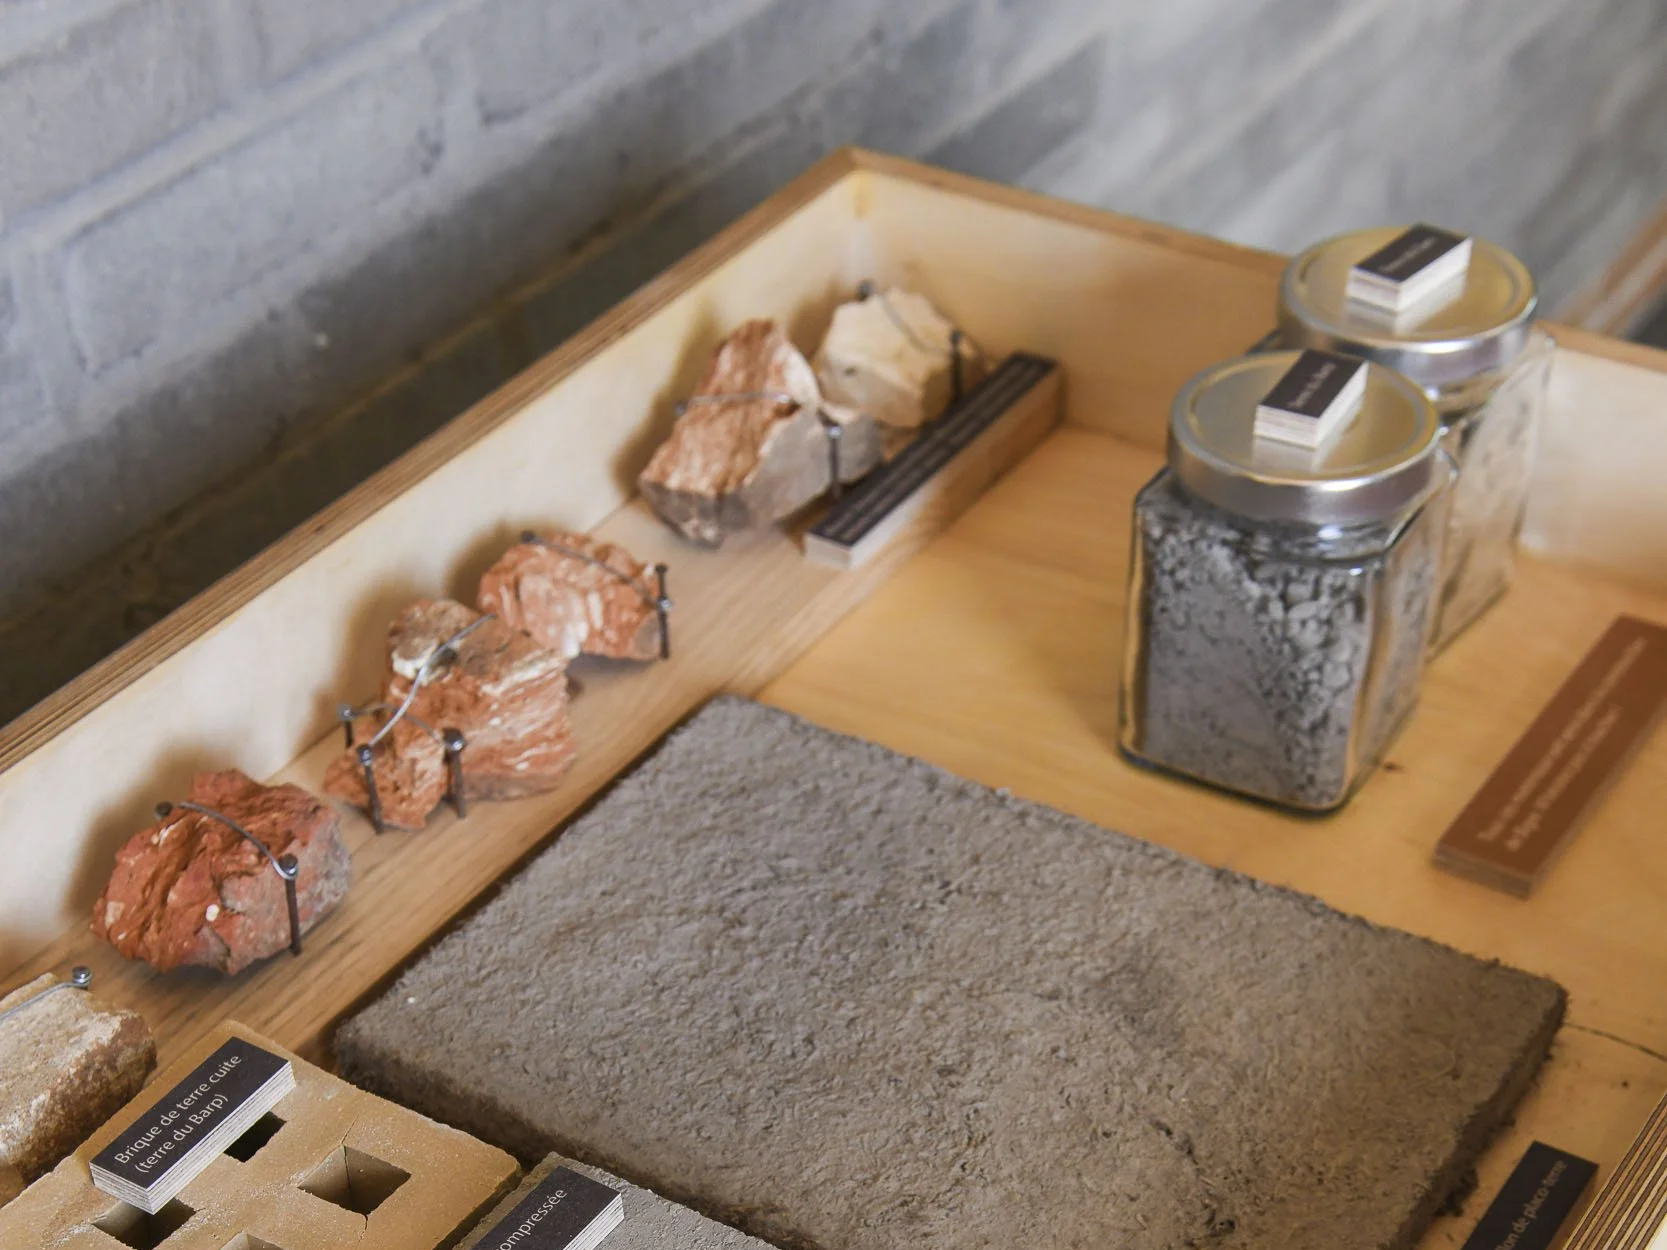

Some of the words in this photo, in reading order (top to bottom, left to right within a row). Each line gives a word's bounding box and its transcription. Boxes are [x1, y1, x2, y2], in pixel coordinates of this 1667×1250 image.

[114, 1126, 162, 1164] Brique
[160, 1109, 180, 1127] de
[176, 1083, 210, 1111] terre
[209, 1055, 242, 1084] cuite
[135, 1142, 175, 1173] (terre
[173, 1124, 194, 1142] du
[189, 1093, 229, 1125] Barp)
[1512, 1215, 1530, 1234] de
